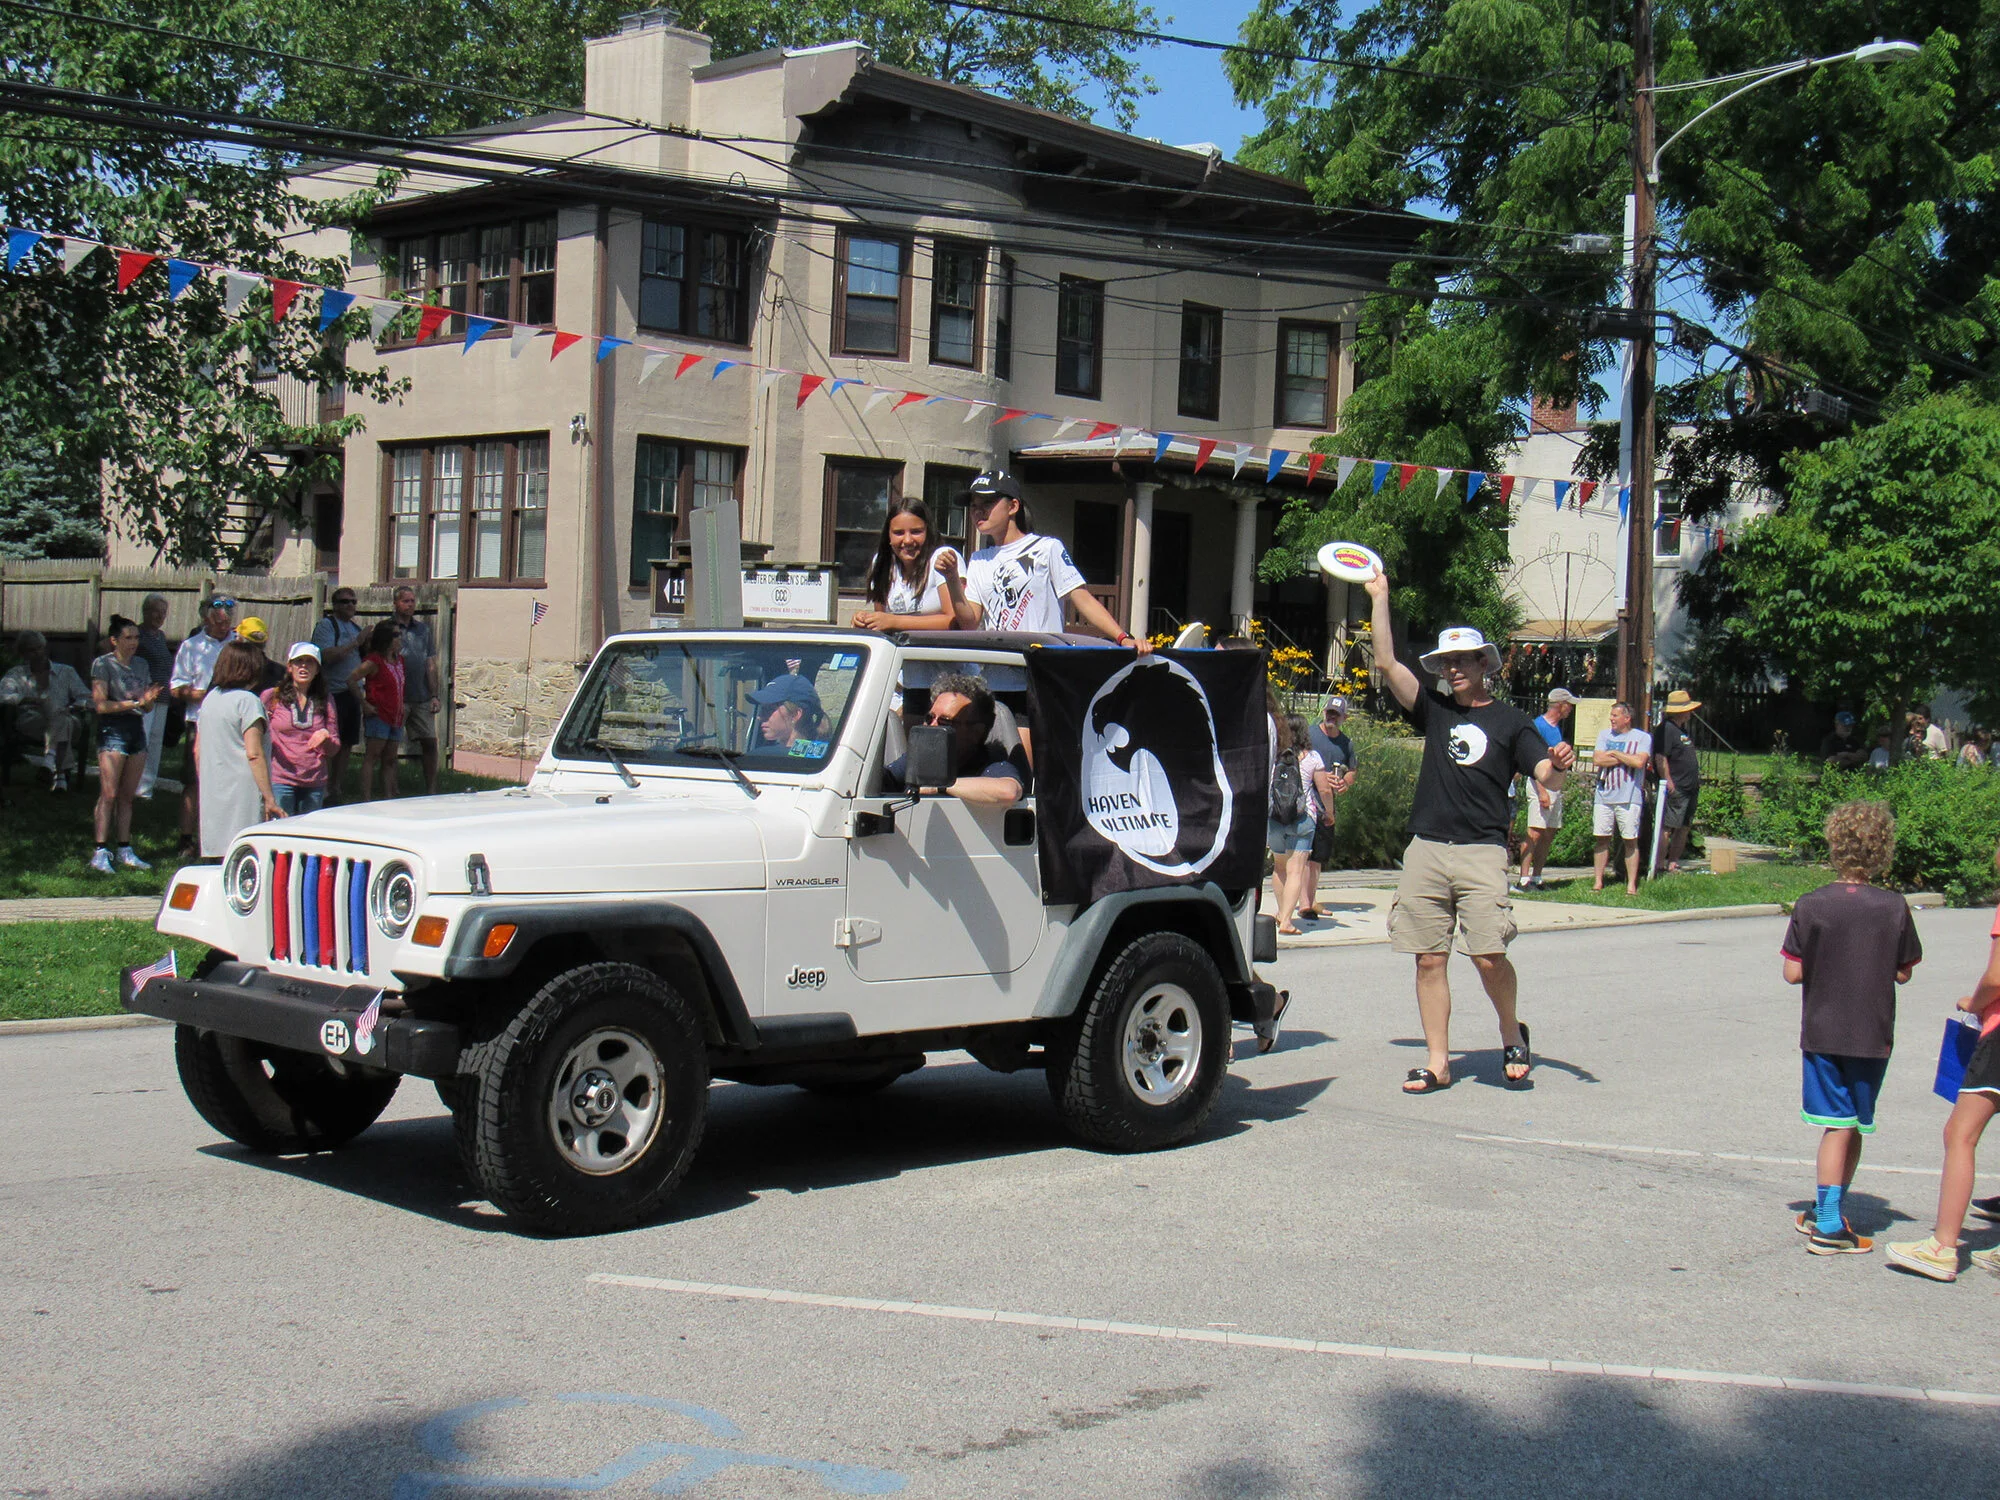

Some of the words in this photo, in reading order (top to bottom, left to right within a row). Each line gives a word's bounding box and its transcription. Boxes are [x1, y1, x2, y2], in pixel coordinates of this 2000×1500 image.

[1010, 589, 1034, 631] ULTIMATE
[1087, 793, 1142, 814] HAVEN
[775, 877, 840, 886] WRANGLER
[787, 967, 826, 987] Jeep
[325, 1023, 347, 1049] EH
